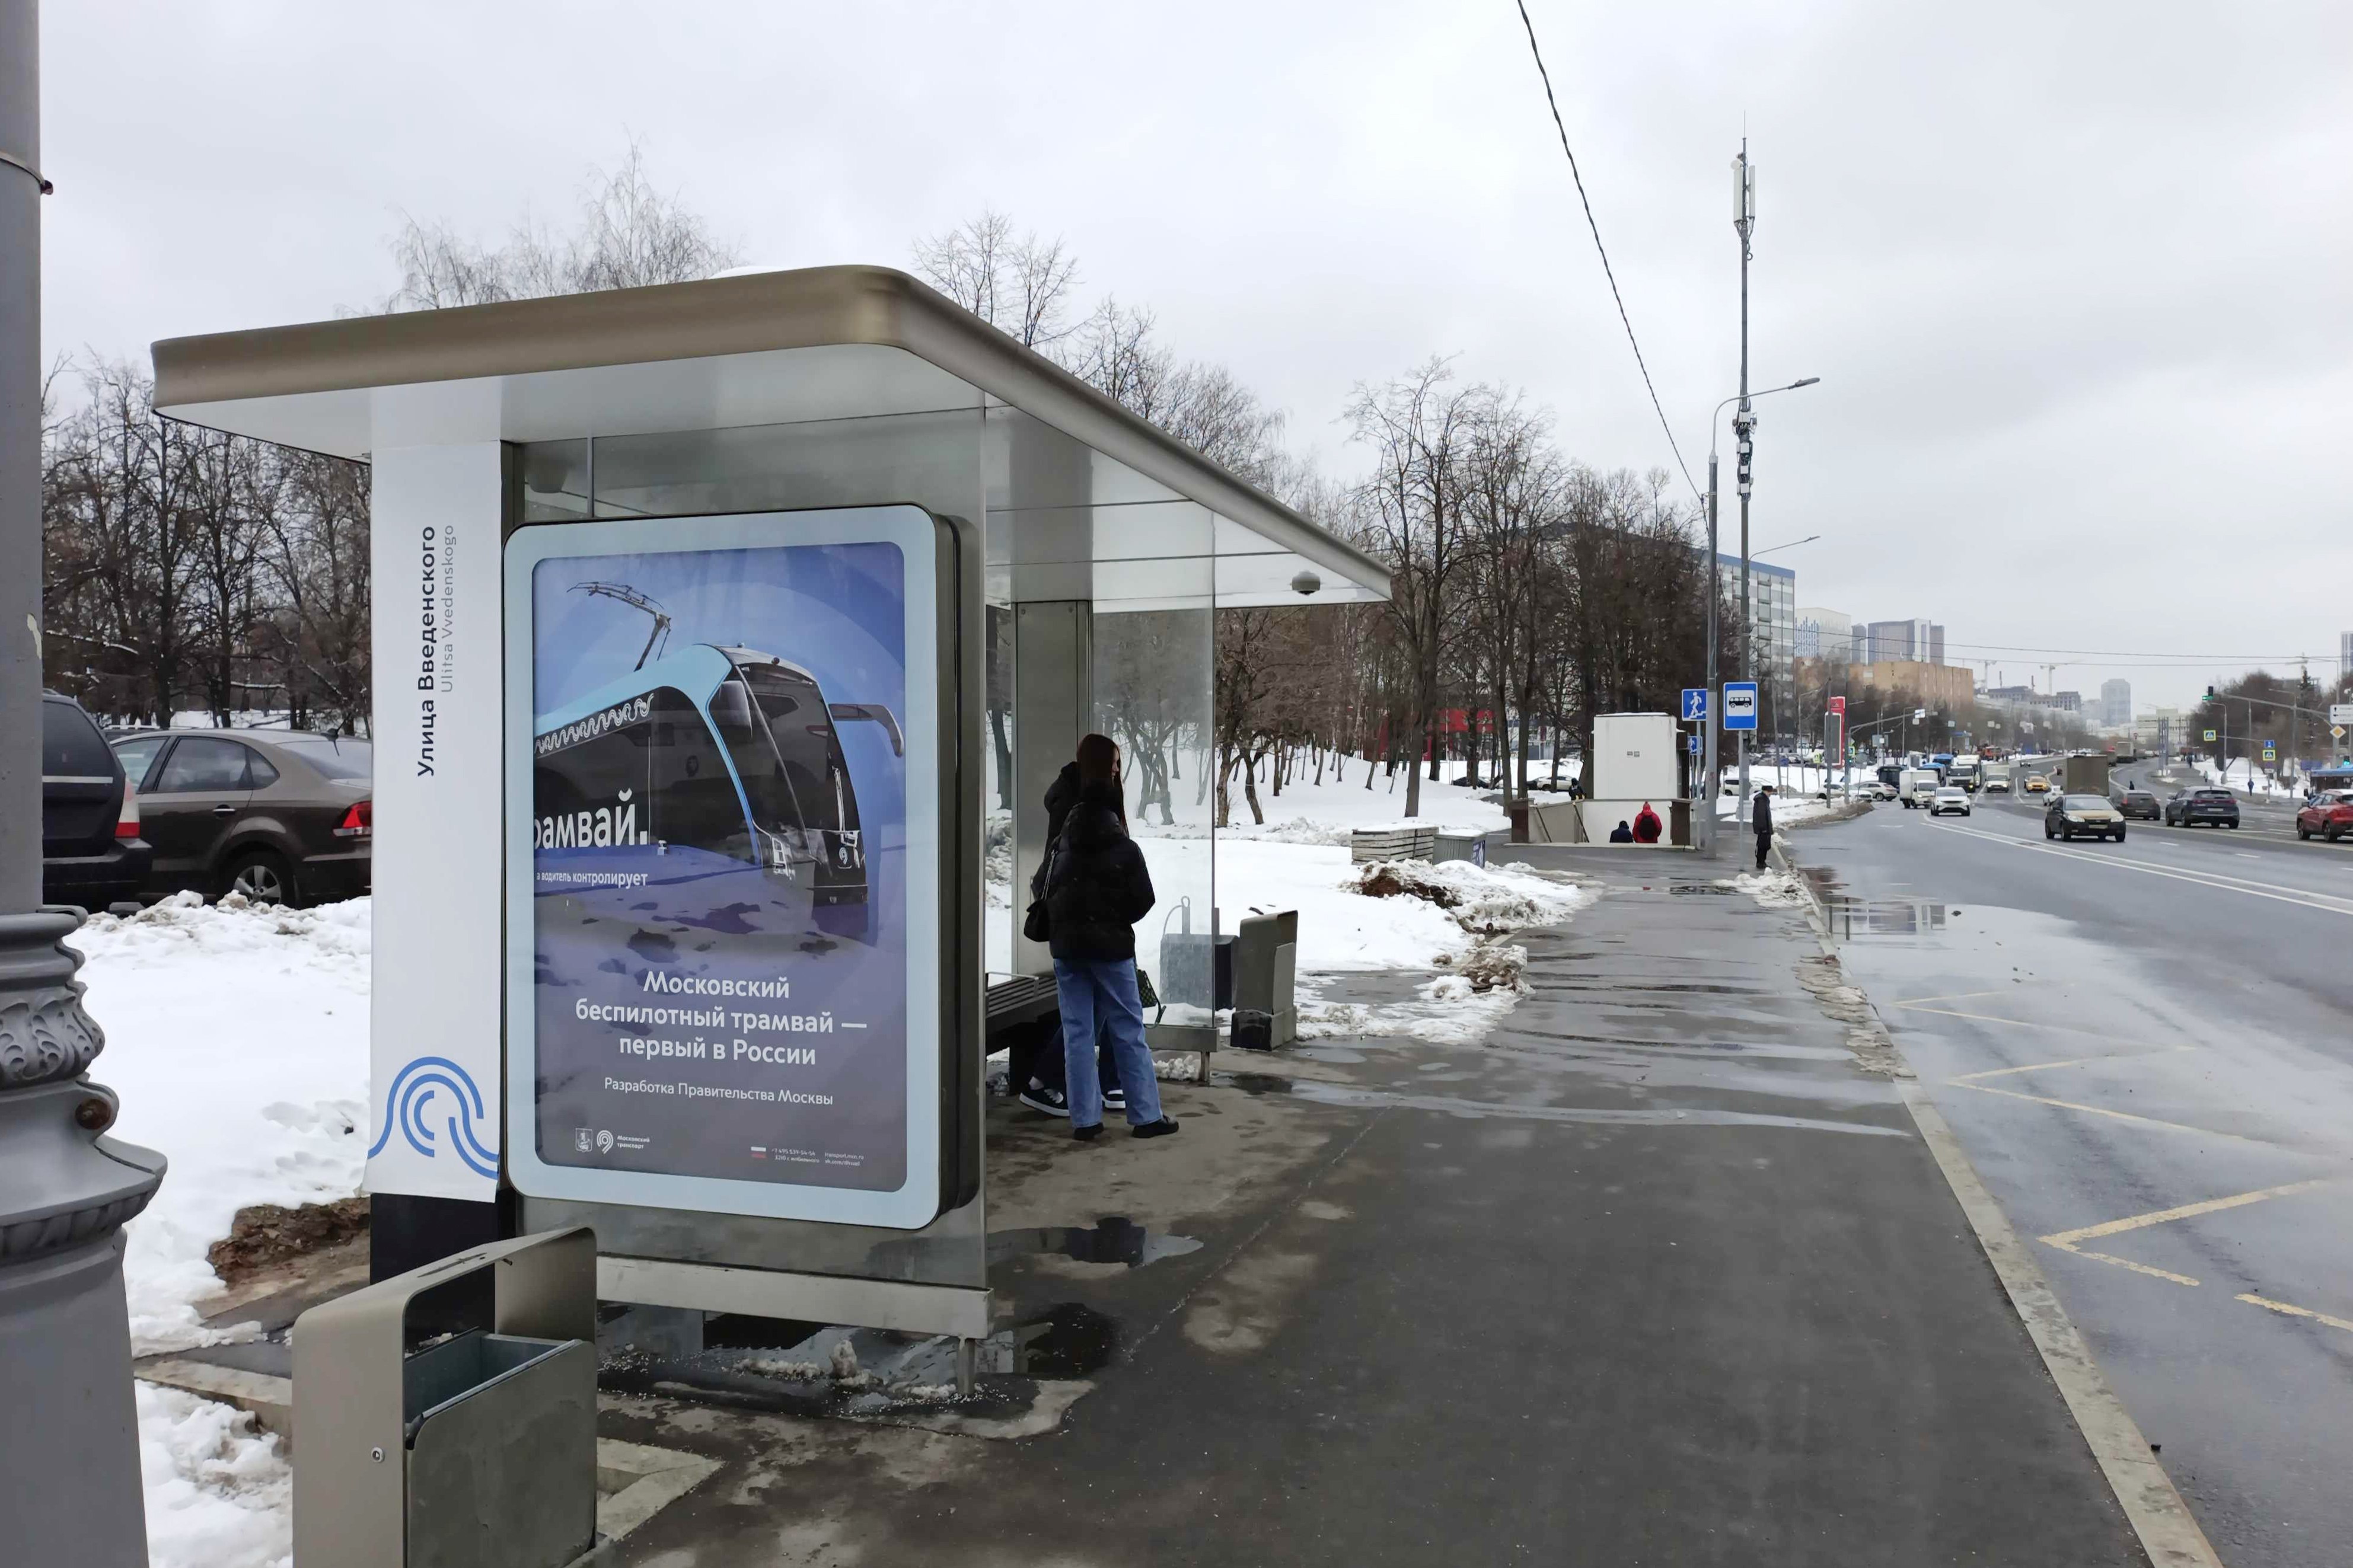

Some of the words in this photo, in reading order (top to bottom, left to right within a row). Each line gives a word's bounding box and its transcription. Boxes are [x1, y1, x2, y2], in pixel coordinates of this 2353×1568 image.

[441, 525, 457, 639] Vvedenskogo
[417, 526, 437, 691] Введенского
[441, 644, 454, 693] Ulitsa
[417, 700, 437, 777] Улица
[541, 872, 572, 882] водитель
[573, 873, 648, 889] контролирует
[643, 970, 790, 998] Московский
[575, 998, 725, 1027] беспилотный
[731, 1011, 833, 1034] трамвай
[619, 1036, 706, 1061] первый
[713, 1043, 726, 1059] в
[733, 1039, 816, 1065] России
[604, 1077, 674, 1095] Разработка
[678, 1083, 774, 1102] Правительства
[777, 1090, 833, 1105] Москвы
